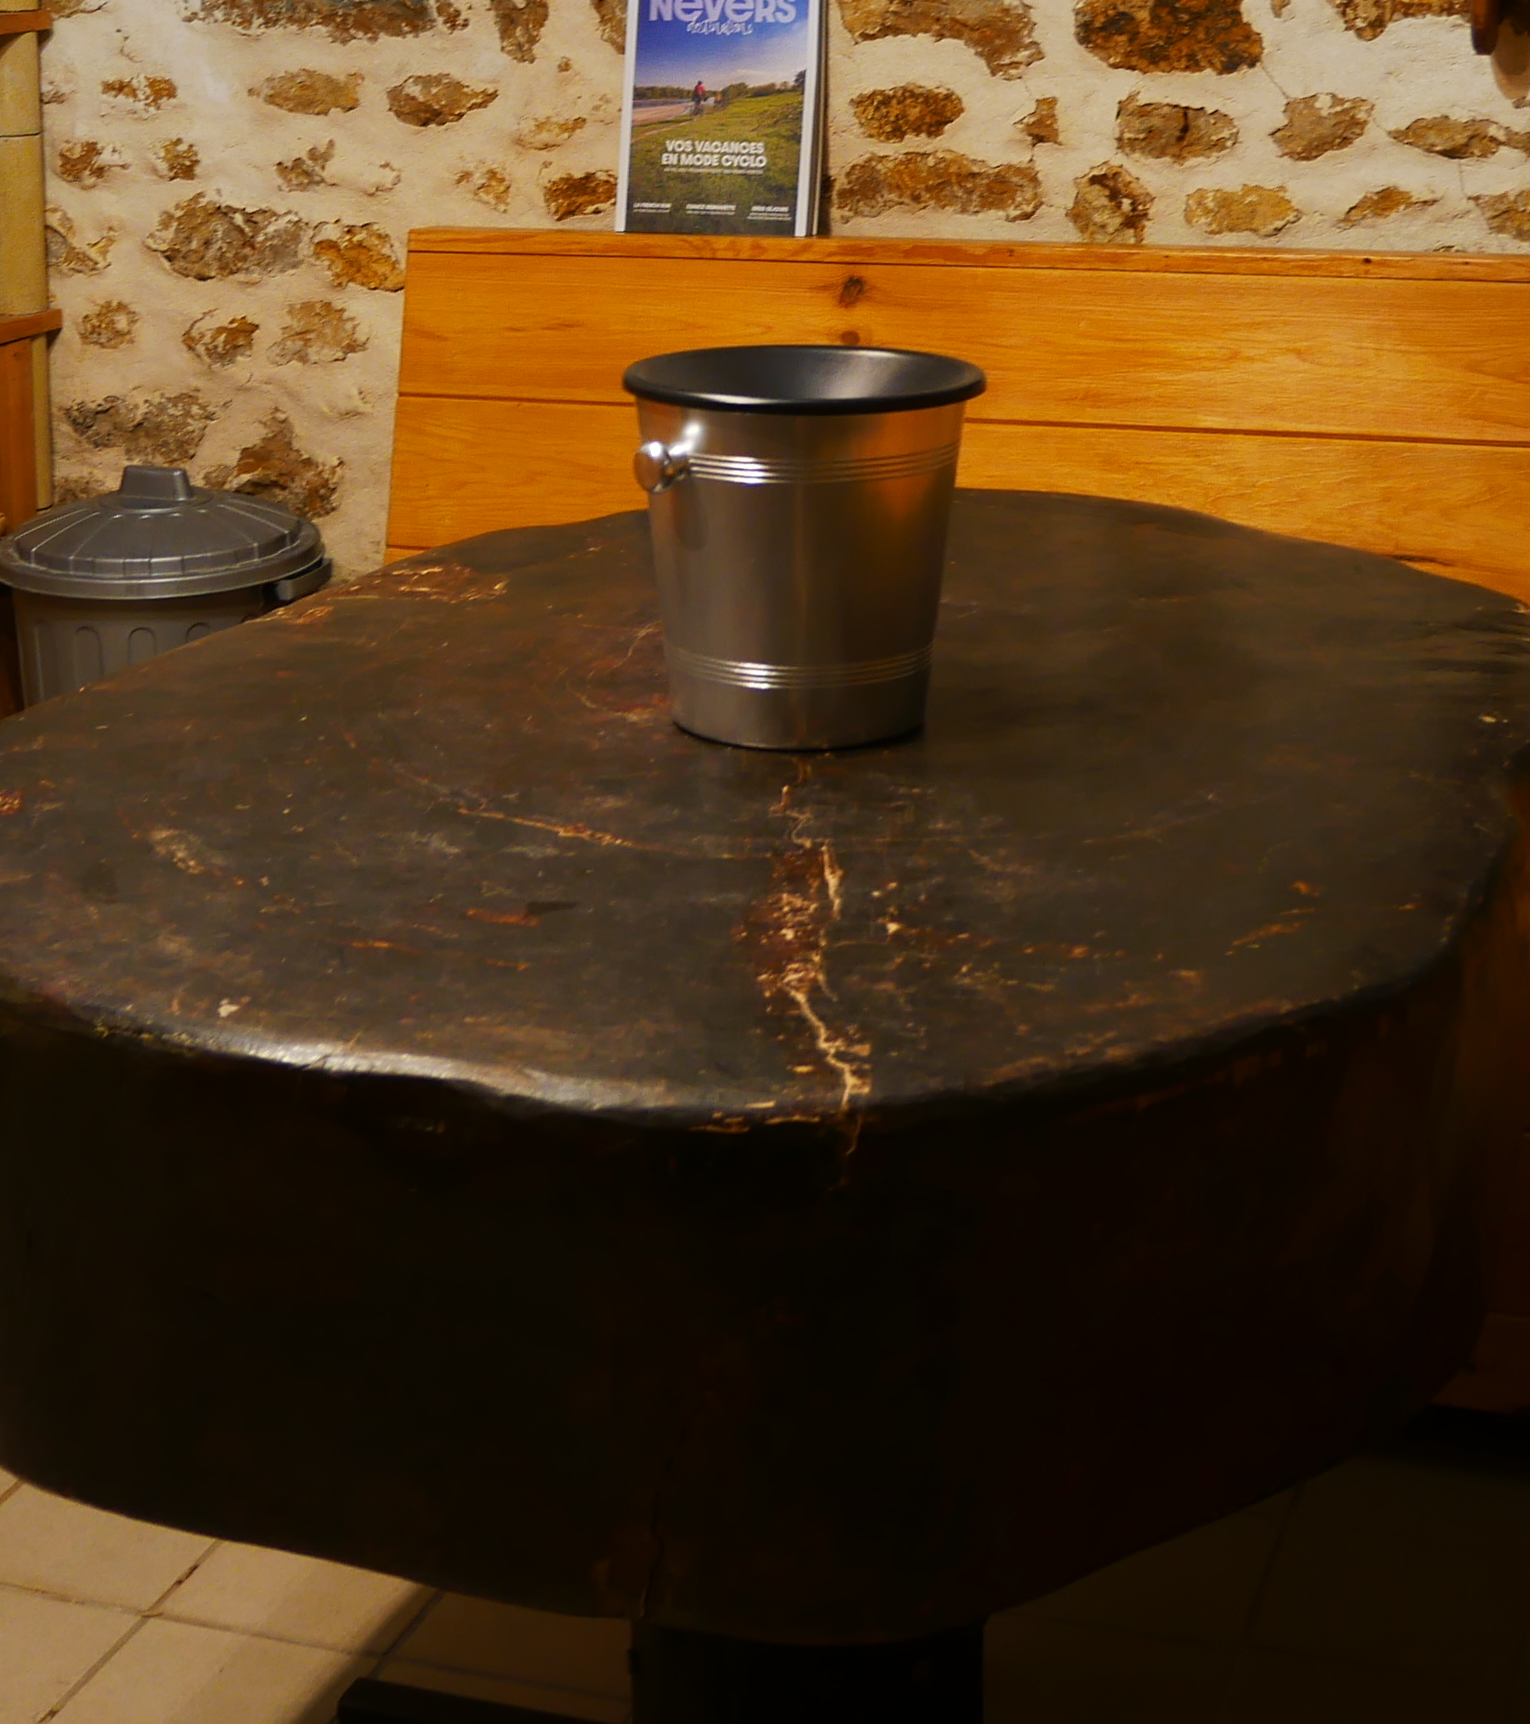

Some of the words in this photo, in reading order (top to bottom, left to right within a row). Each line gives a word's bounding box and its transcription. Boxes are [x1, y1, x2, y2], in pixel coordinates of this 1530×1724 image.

[665, 139, 693, 153] VOS
[694, 139, 765, 155] VACANCES
[661, 153, 678, 166] EN
[679, 153, 720, 167] MODE
[721, 154, 768, 168] CYCLO
